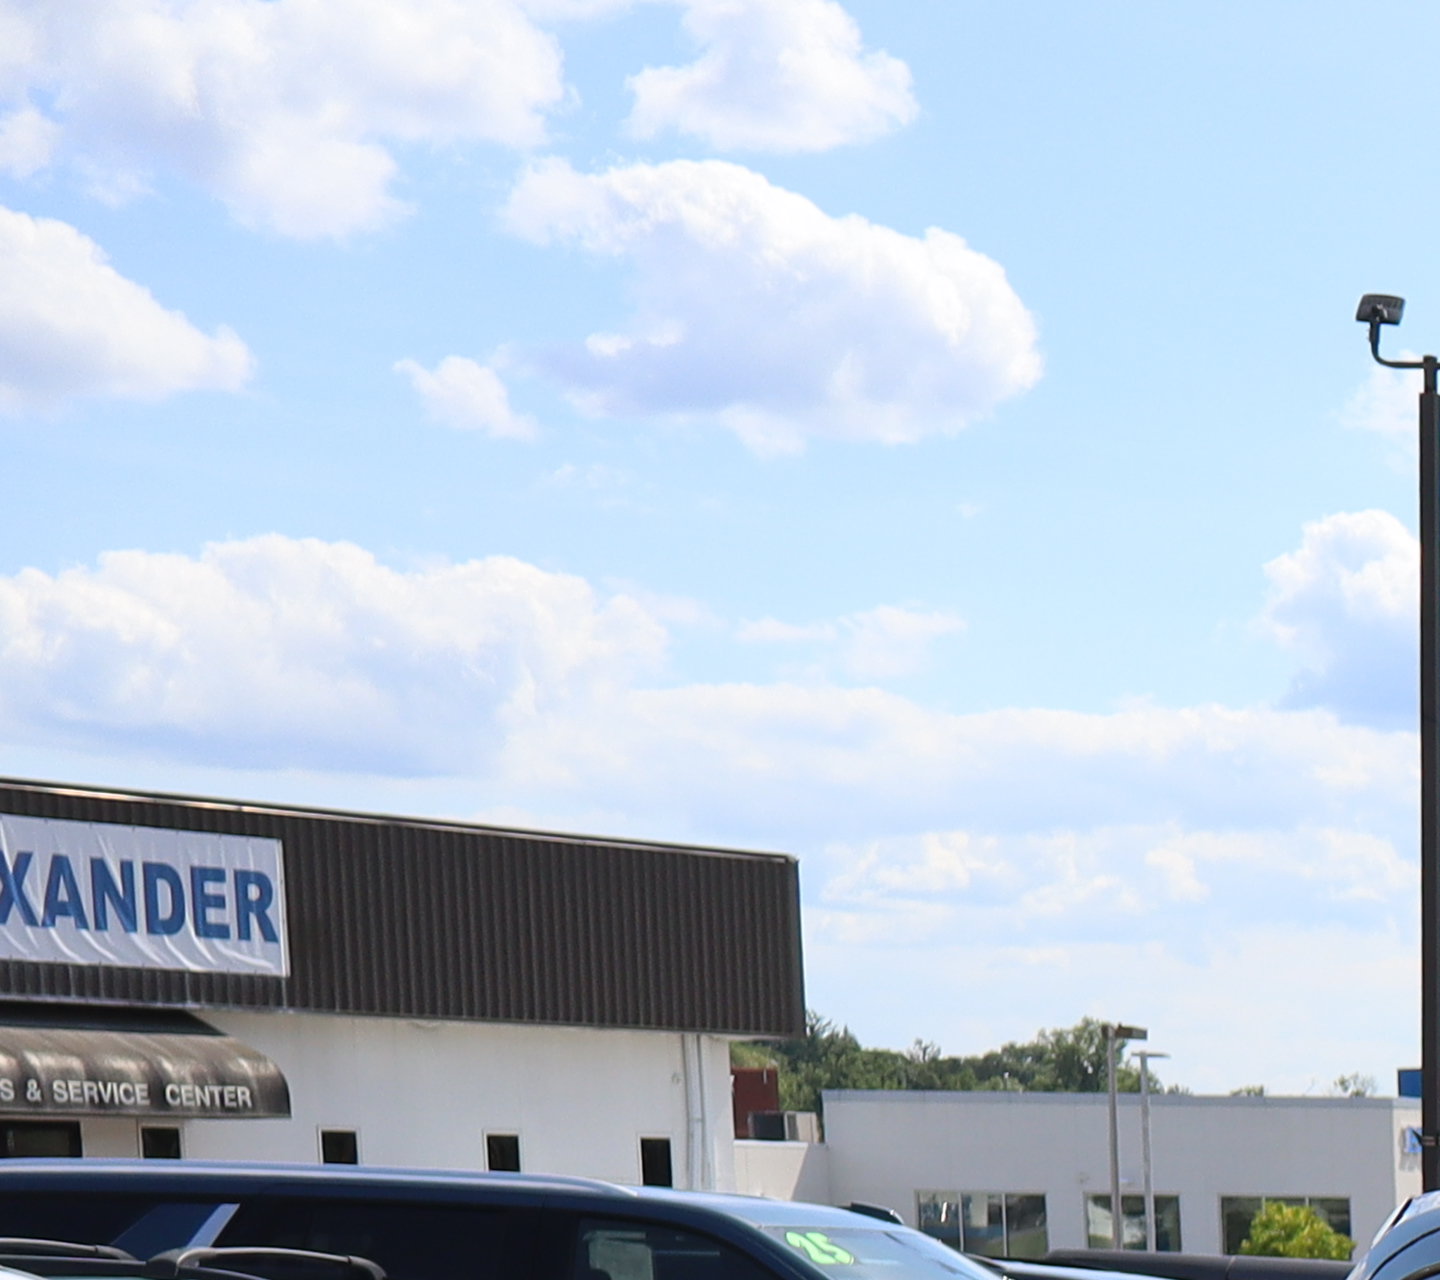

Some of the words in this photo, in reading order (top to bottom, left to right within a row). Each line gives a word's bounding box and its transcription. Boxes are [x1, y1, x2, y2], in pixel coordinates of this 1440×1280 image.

[0, 852, 279, 944] XANDER
[26, 1079, 42, 1101] &
[53, 1079, 150, 1106] SERVICE
[165, 1084, 252, 1108] CENTER
[786, 1231, 854, 1265] 25
